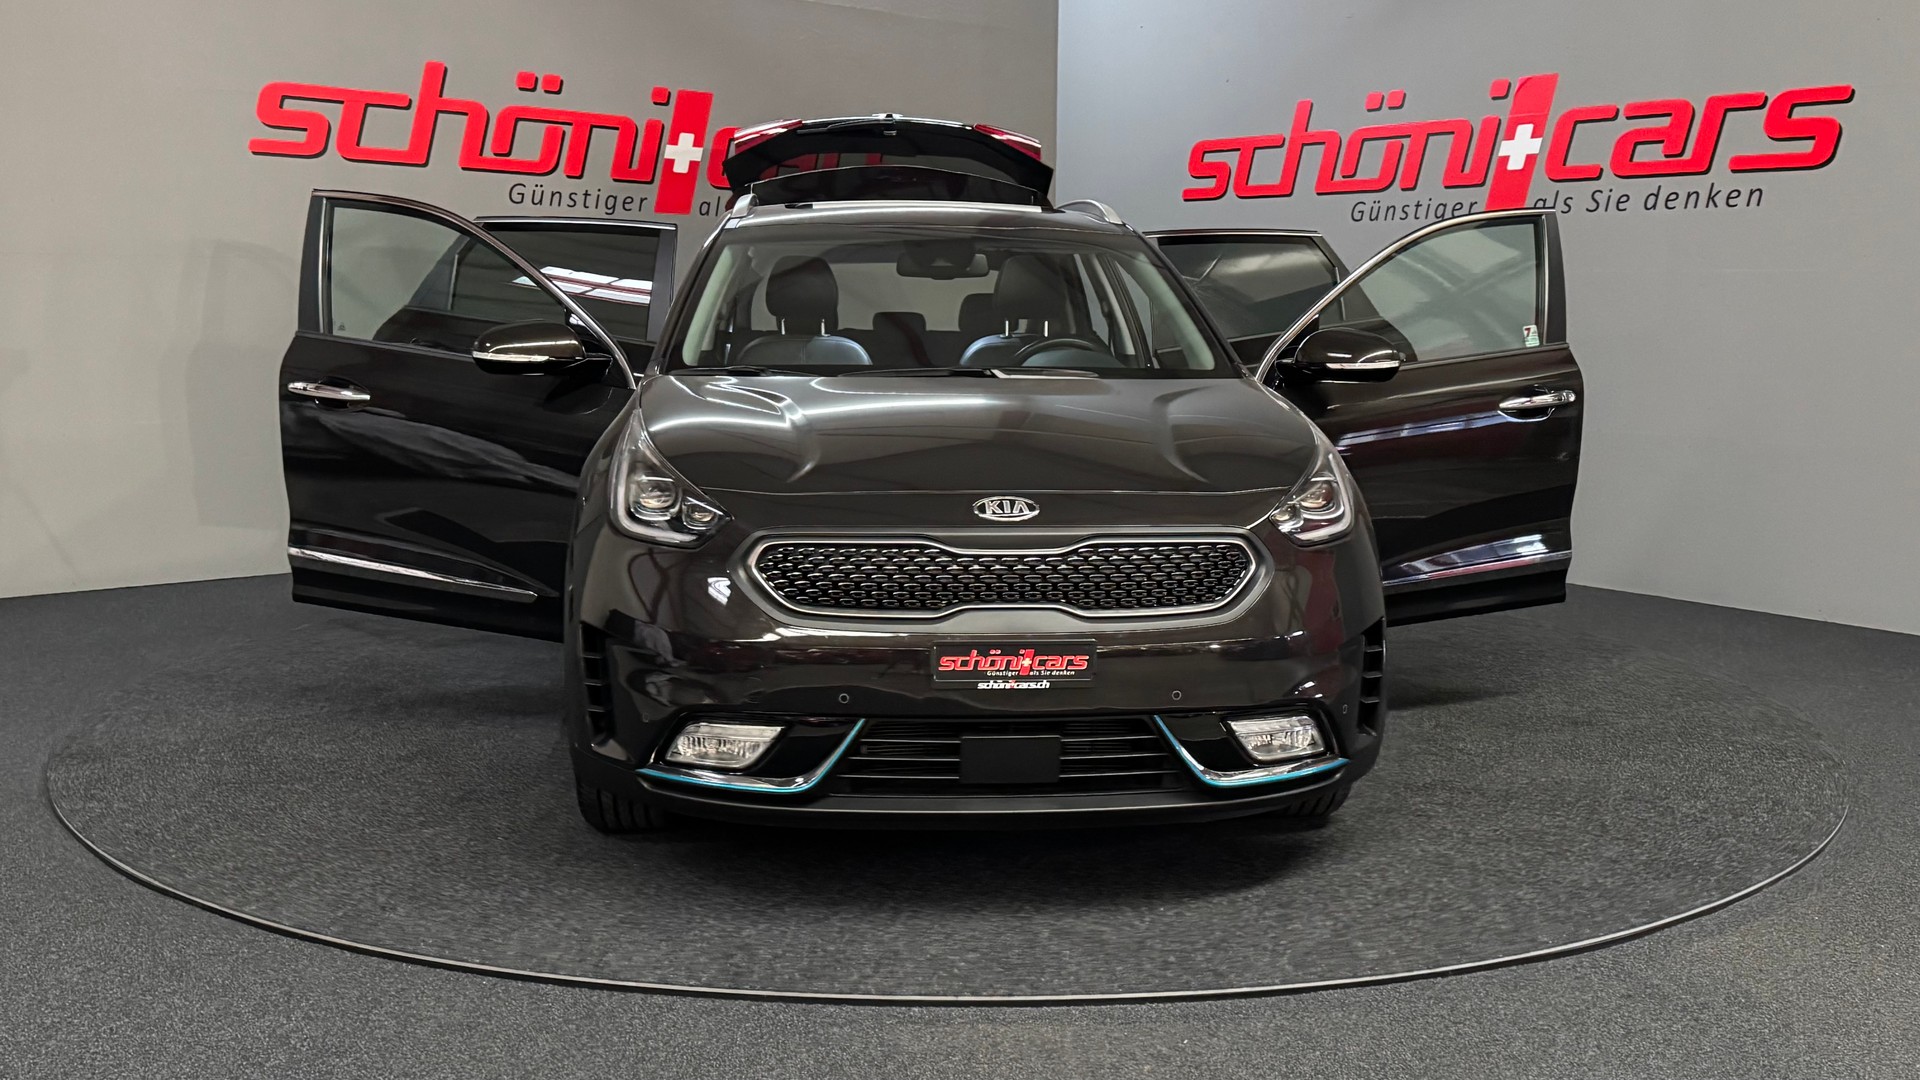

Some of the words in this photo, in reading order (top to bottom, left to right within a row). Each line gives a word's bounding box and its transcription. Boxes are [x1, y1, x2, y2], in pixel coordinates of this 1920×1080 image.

[508, 182, 648, 215] Günstiger
[699, 195, 721, 217] al
[1350, 197, 1478, 222] Günstiger
[1533, 189, 1574, 214] als
[1585, 188, 1631, 213] Sie
[1643, 182, 1764, 211] denken
[984, 500, 1030, 514] KIA
